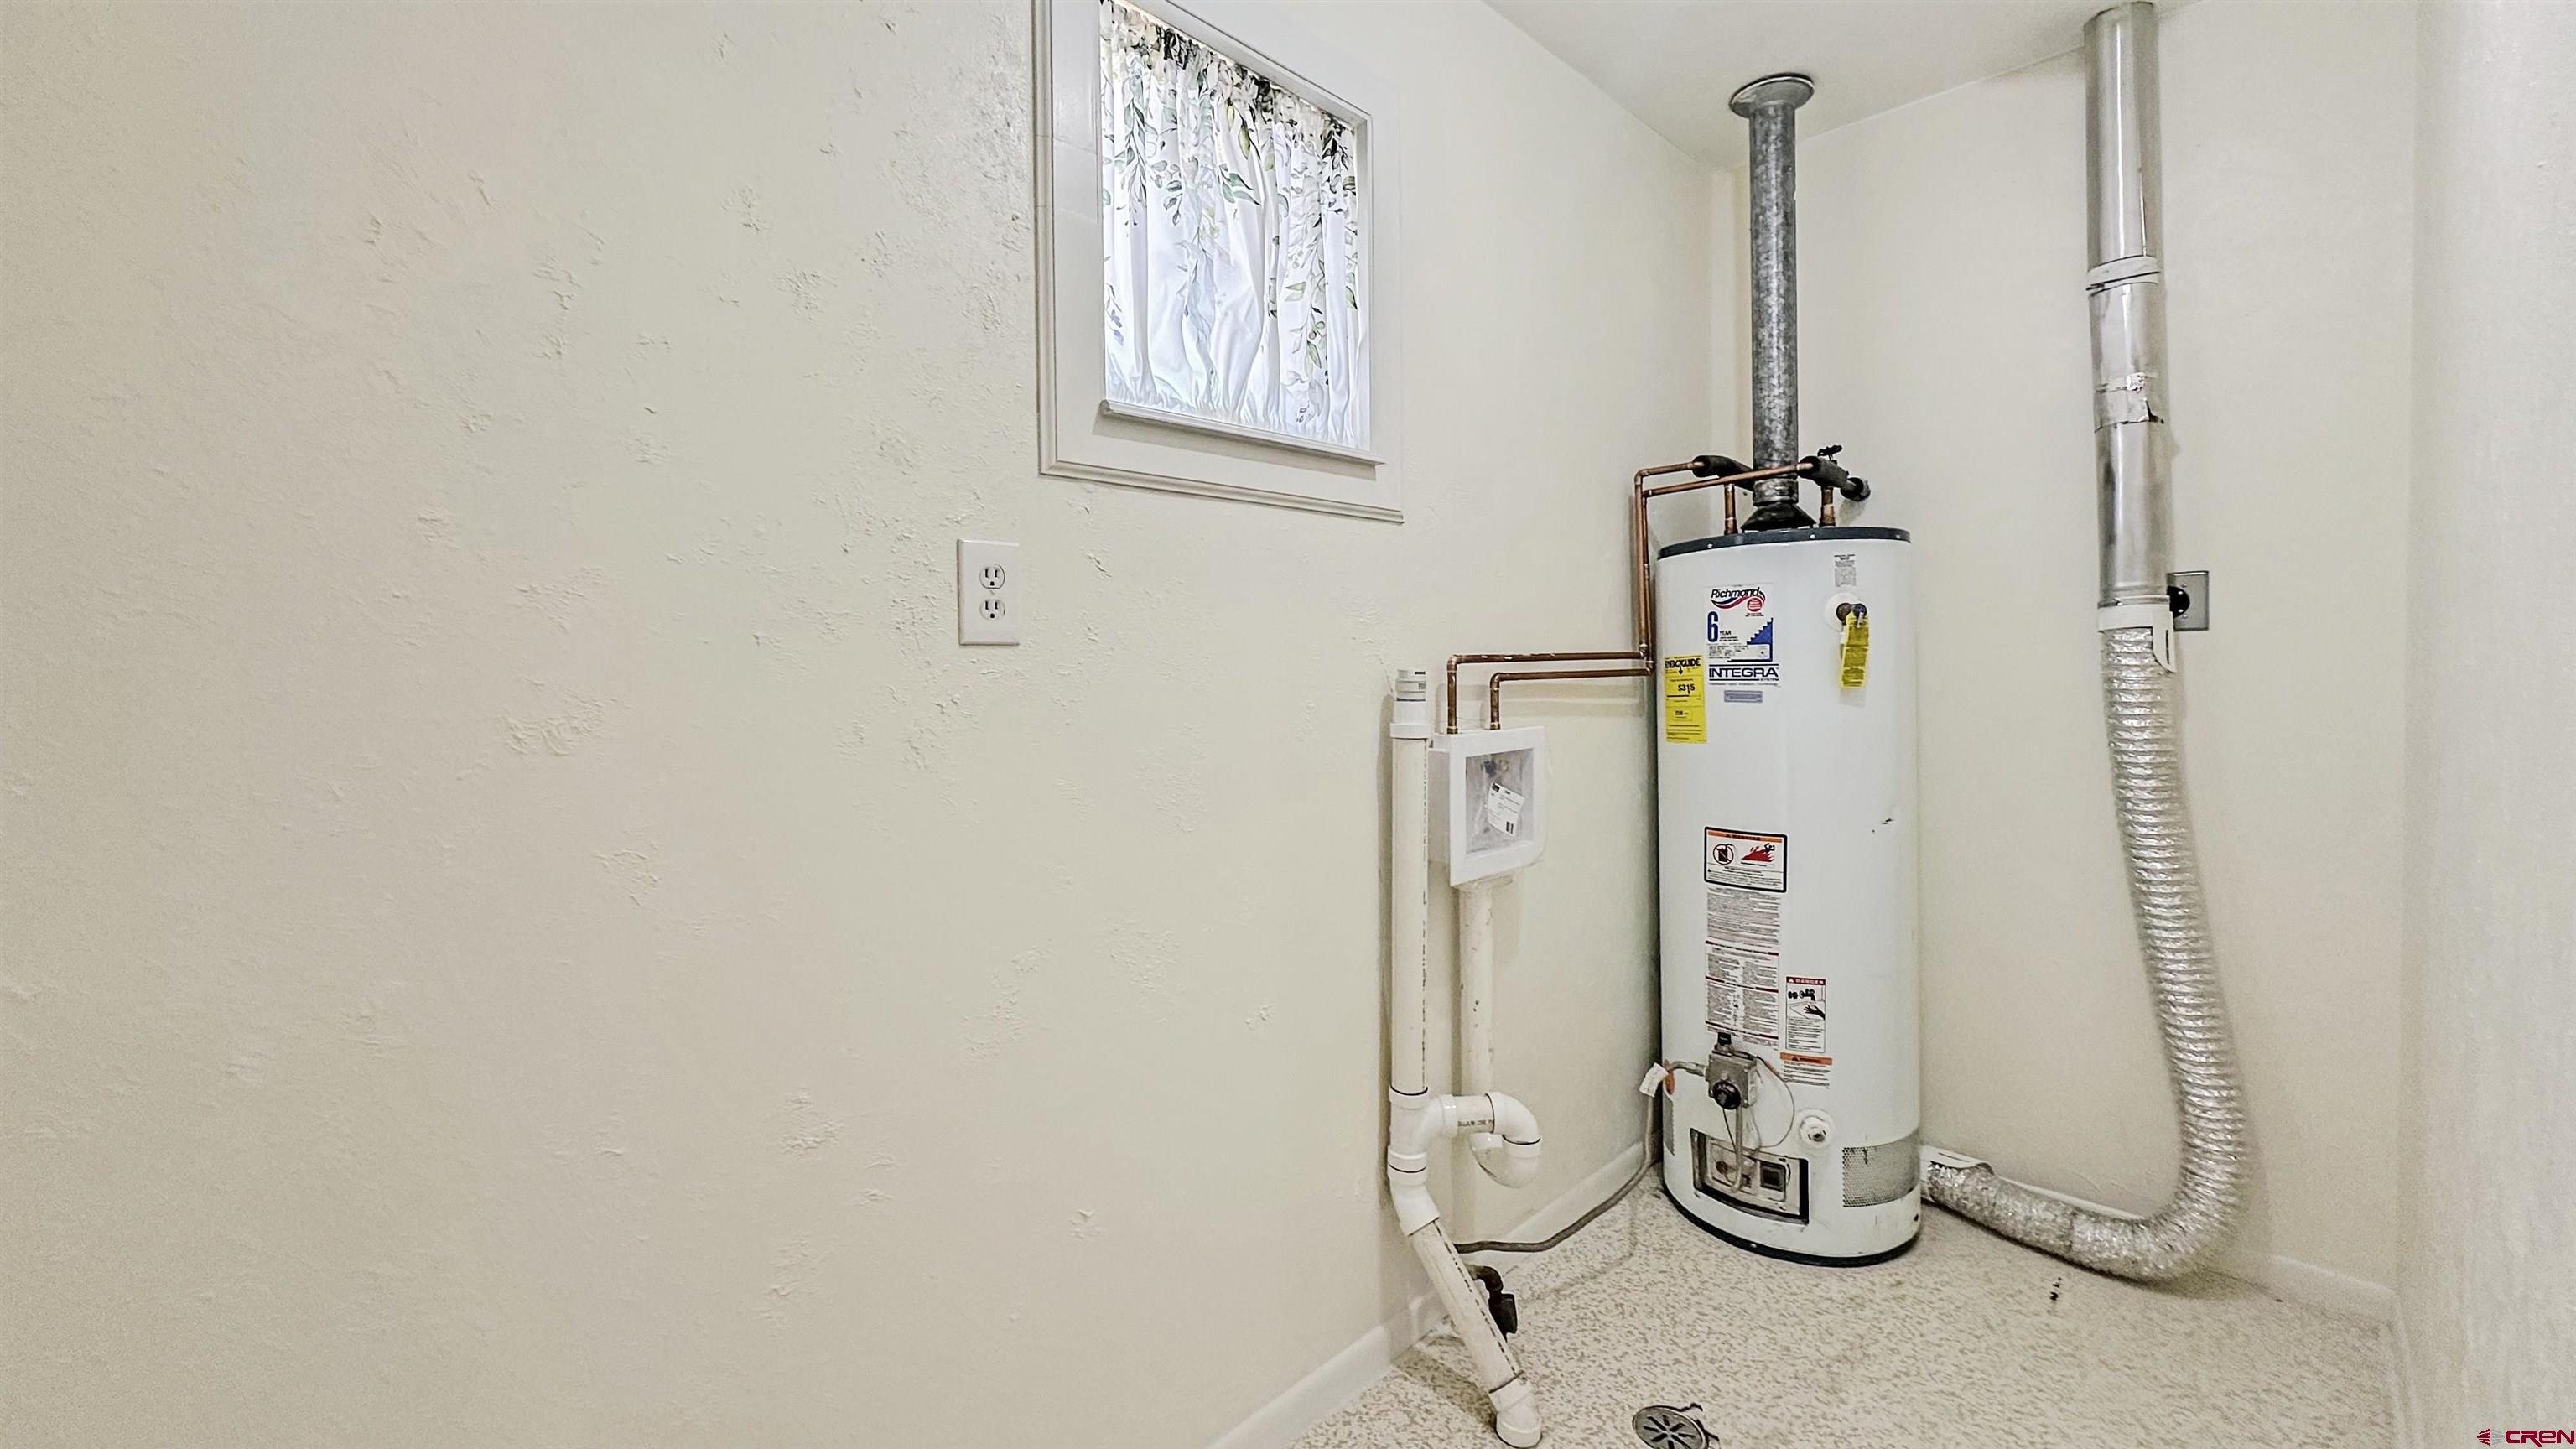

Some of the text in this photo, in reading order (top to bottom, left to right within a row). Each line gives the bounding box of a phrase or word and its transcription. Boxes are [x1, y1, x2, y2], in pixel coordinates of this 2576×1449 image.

[1711, 586, 1760, 599] Richmond
[1707, 611, 1719, 642] 6
[1708, 667, 1779, 678] INTEGRA
